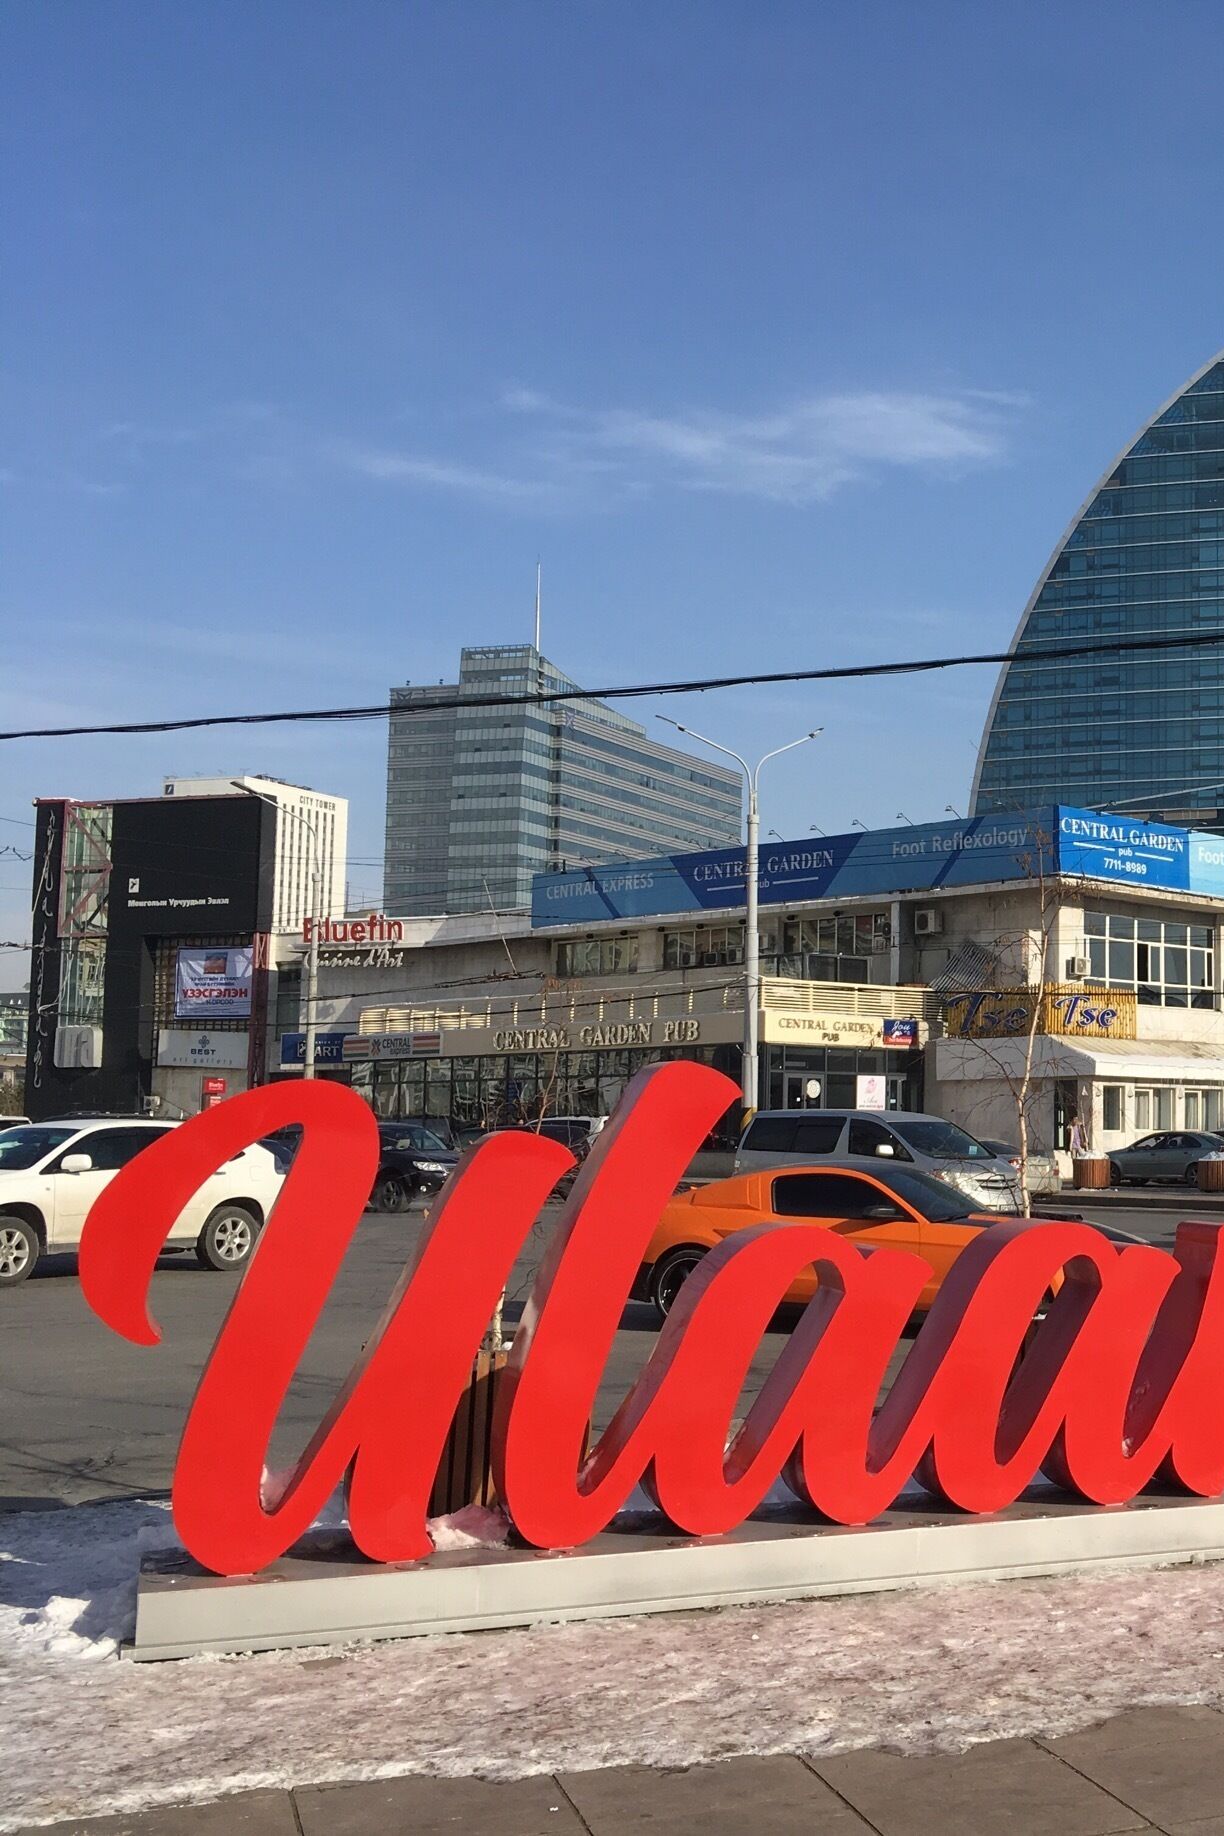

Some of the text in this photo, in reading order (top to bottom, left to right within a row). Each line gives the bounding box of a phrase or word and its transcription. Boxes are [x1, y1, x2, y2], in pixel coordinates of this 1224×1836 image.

[300, 795, 336, 811] CITY TOWER
[892, 827, 1028, 858] Foot Reflexology
[1061, 817, 1184, 853] CENTRAL GARDEN
[767, 850, 834, 873] GARDEN
[1118, 848, 1133, 857] pub
[1198, 847, 1224, 866] Foot
[1104, 858, 1147, 875] 7711-8989
[546, 873, 654, 900] CENTRAL EXPRESS
[946, 990, 1029, 1034] Tse
[1055, 995, 1118, 1028] Tse
[494, 1019, 699, 1050] CENTRAL GARDEN PUB
[778, 1018, 875, 1034] CENTRAL GARDEN
[382, 1038, 411, 1048] CENTRAL
[822, 1033, 840, 1042] PUB
